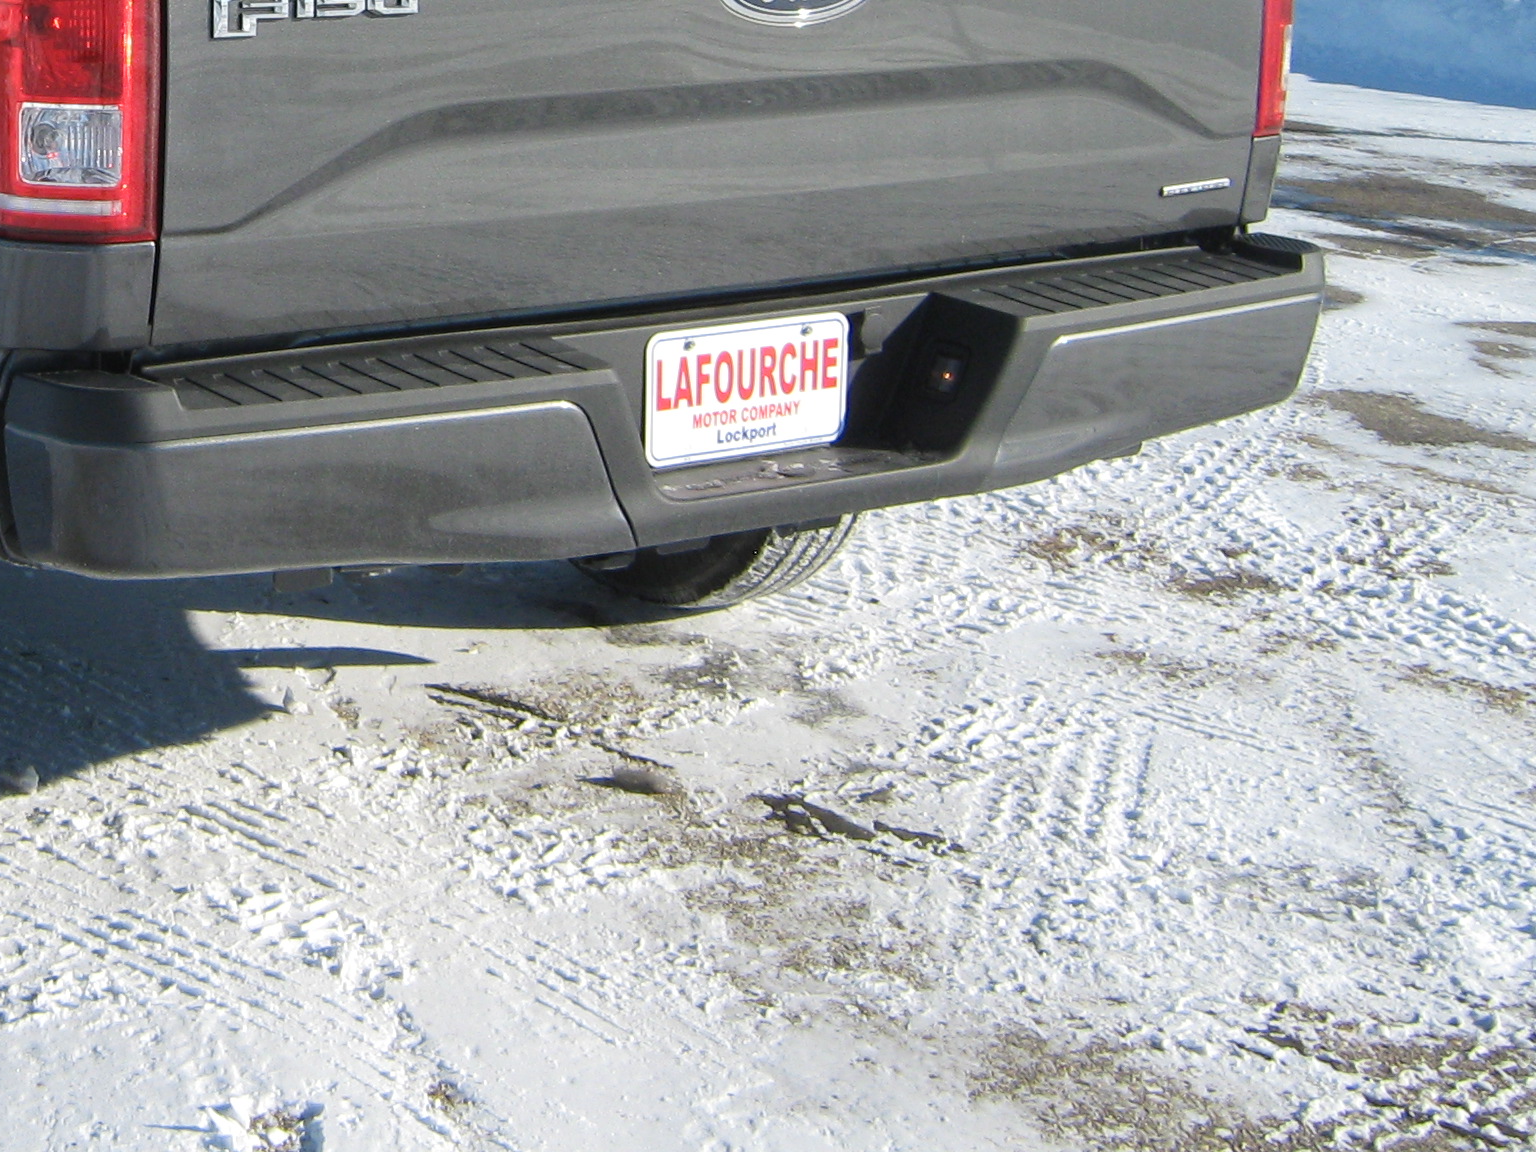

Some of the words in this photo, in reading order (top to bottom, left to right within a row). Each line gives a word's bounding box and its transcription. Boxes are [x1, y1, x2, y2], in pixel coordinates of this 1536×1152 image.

[656, 337, 839, 412] LAFOURCHE
[692, 409, 738, 429] MOTOR
[740, 400, 801, 423] COMPANY
[716, 423, 777, 443] Lockport
